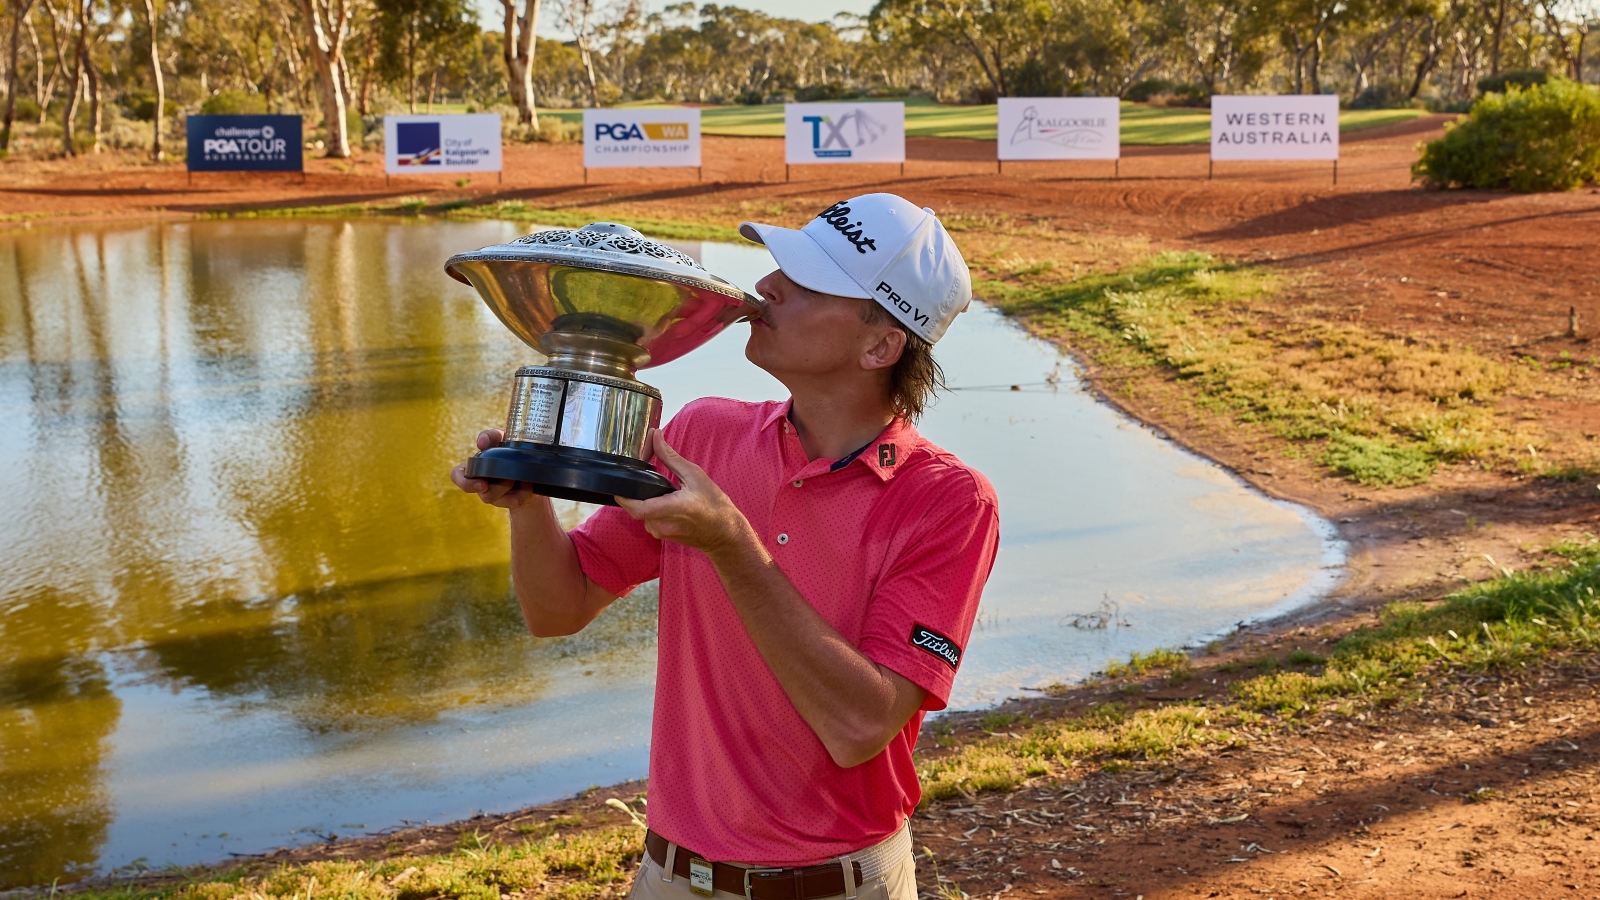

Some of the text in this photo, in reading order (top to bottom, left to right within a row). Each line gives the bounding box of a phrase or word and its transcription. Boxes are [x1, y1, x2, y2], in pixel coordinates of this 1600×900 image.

[1037, 118, 1108, 127] KALGOORLIE
[1226, 113, 1325, 125] WESTERN
[215, 126, 260, 138] challenger
[595, 123, 686, 141] PGA WA
[1217, 131, 1332, 144] AUSTRALIA
[444, 138, 472, 148] City of
[595, 144, 690, 154] CHAMPIONSHIP
[445, 157, 479, 165] Boulder
[876, 281, 913, 314] PRO
[878, 443, 897, 466] FJ
[913, 630, 959, 665] Titleist
